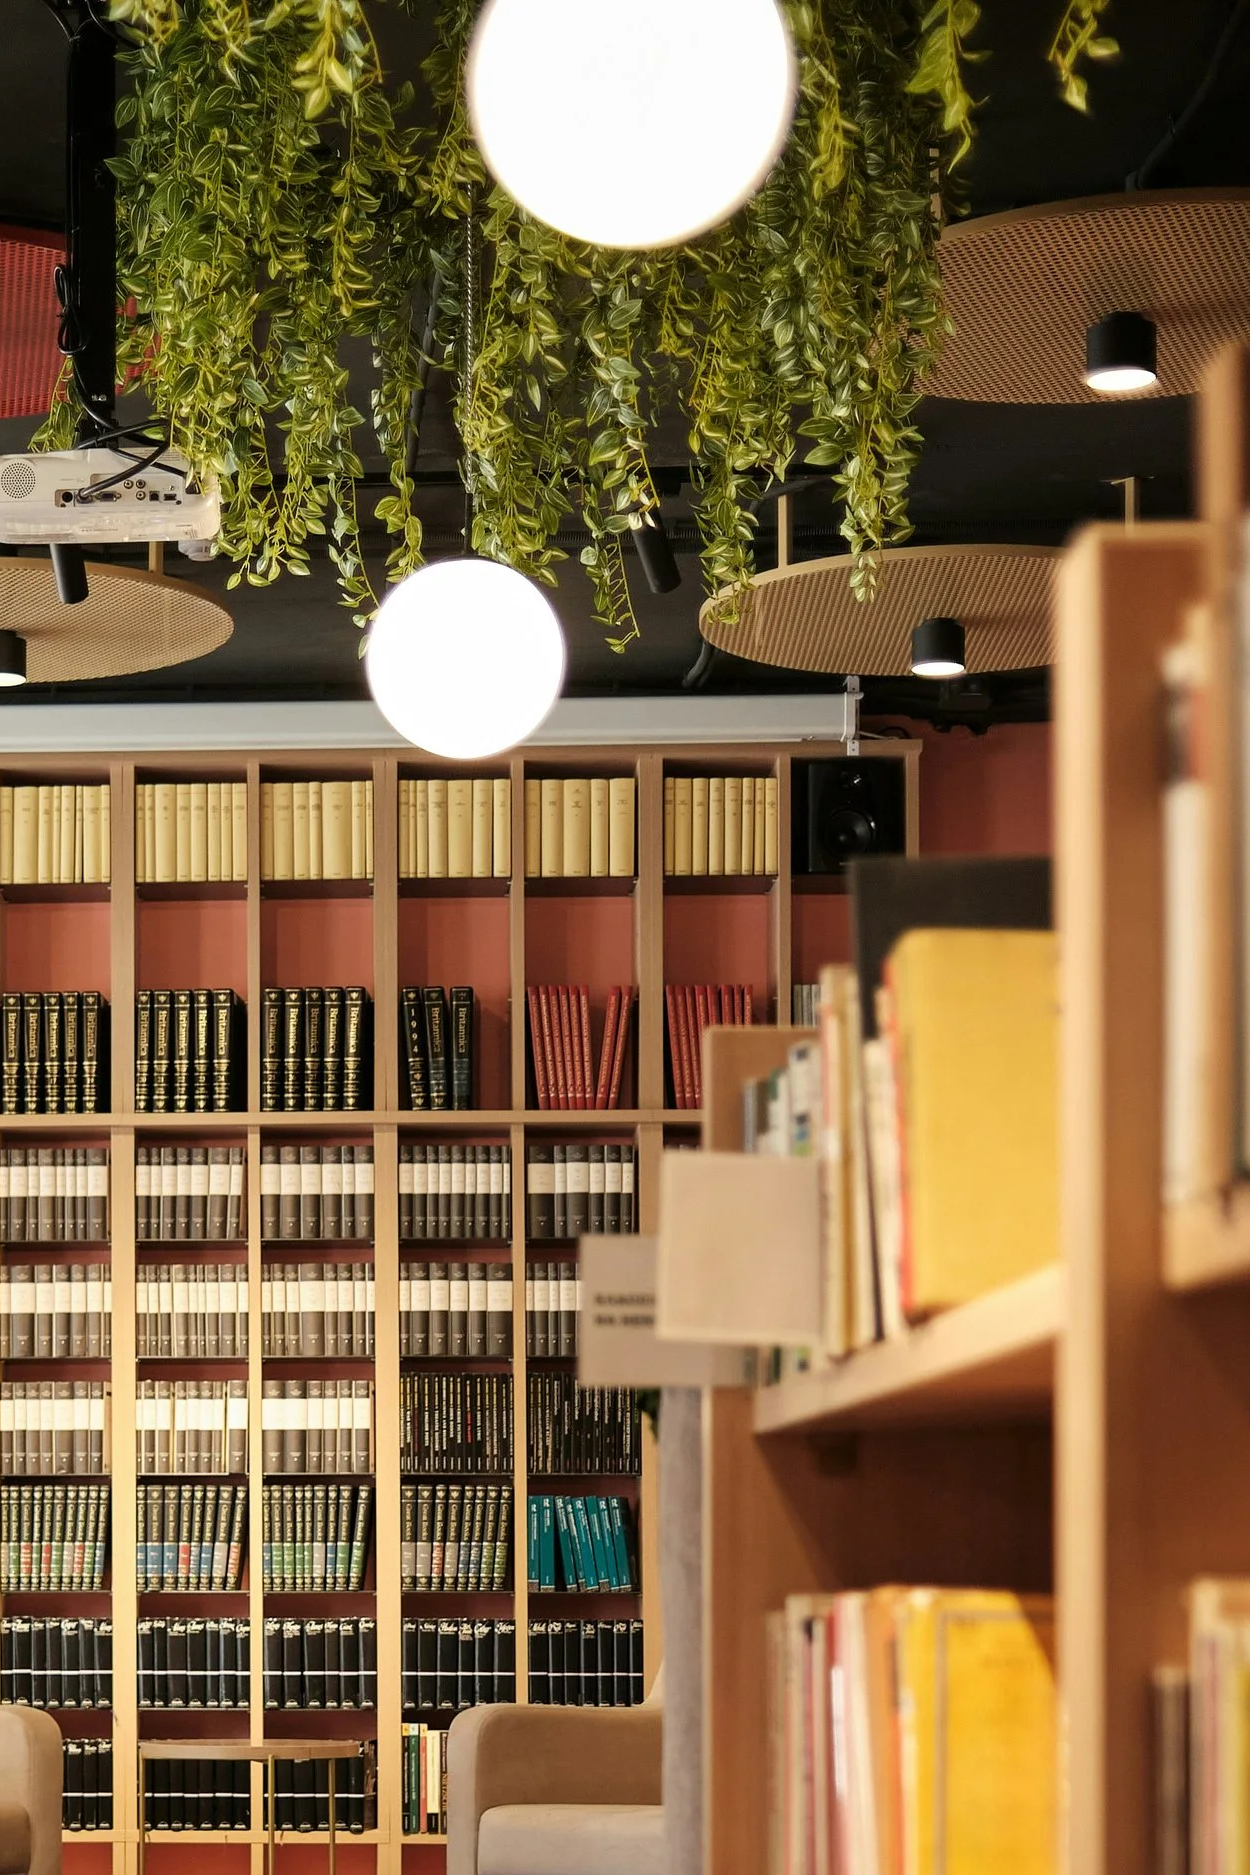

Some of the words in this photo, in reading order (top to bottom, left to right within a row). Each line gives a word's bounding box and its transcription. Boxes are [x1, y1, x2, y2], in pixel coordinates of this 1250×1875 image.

[8, 1013, 17, 1058] Britannica
[29, 1013, 38, 1058] Britannica
[50, 1013, 58, 1058] Britannica
[67, 1013, 76, 1058] Britannica
[88, 1013, 96, 1058] Britannica
[140, 1010, 149, 1056] Britannica
[158, 1010, 167, 1056] Britannica
[179, 1010, 188, 1056] Britannica
[199, 1010, 207, 1056] Britannica
[218, 1010, 227, 1056] Britannica
[268, 1008, 278, 1053] Britannica
[289, 1008, 298, 1053] Britannica
[310, 1008, 320, 1053] Britannica
[329, 1008, 338, 1053] Britannica
[350, 1008, 359, 1053] Britannica
[410, 1008, 419, 1053] 1994
[432, 1007, 442, 1052] Britannica
[458, 1007, 466, 1053] Britannica
